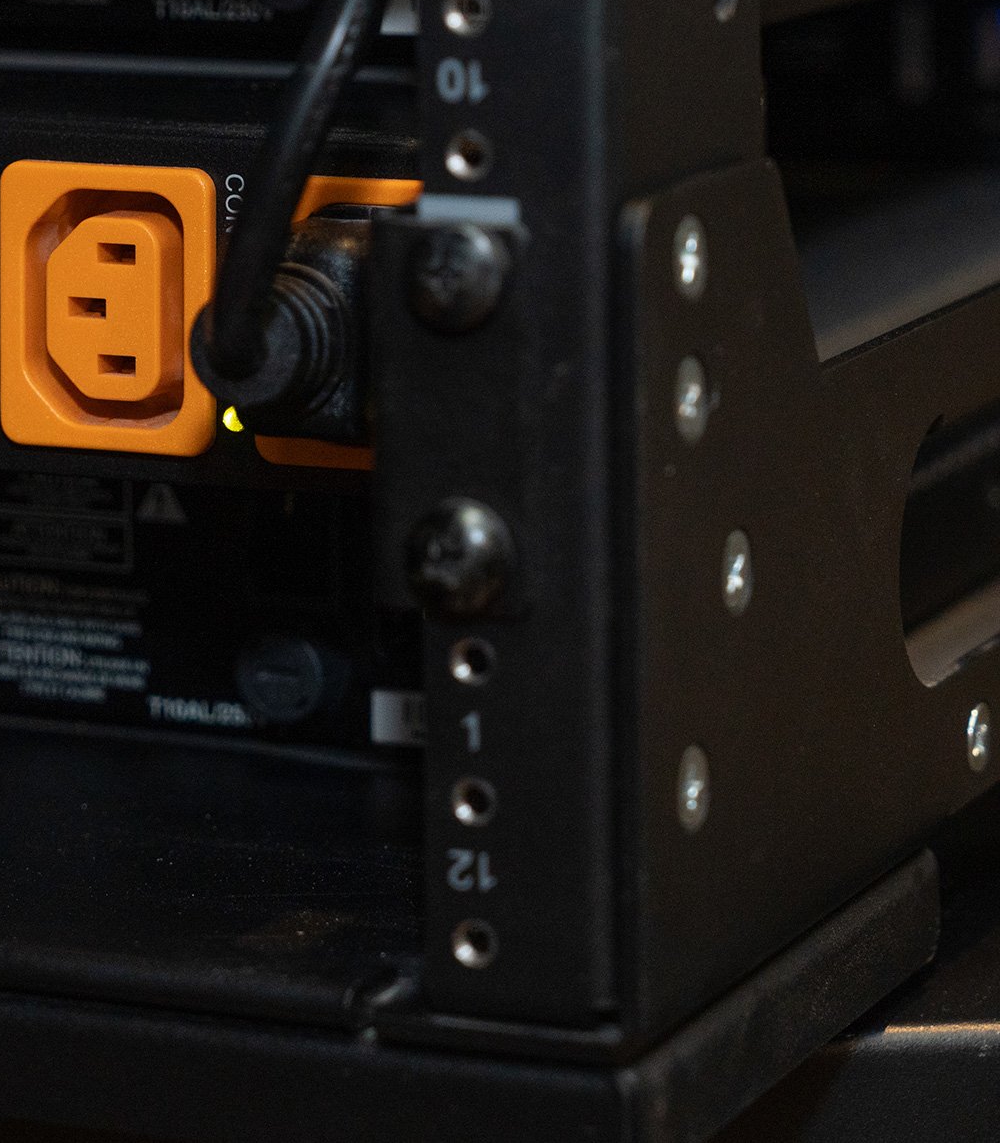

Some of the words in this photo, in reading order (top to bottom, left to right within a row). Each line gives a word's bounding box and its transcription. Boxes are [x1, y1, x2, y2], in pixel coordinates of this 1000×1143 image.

[437, 58, 487, 103] 10
[461, 712, 481, 752] 1
[448, 848, 497, 892] 12
